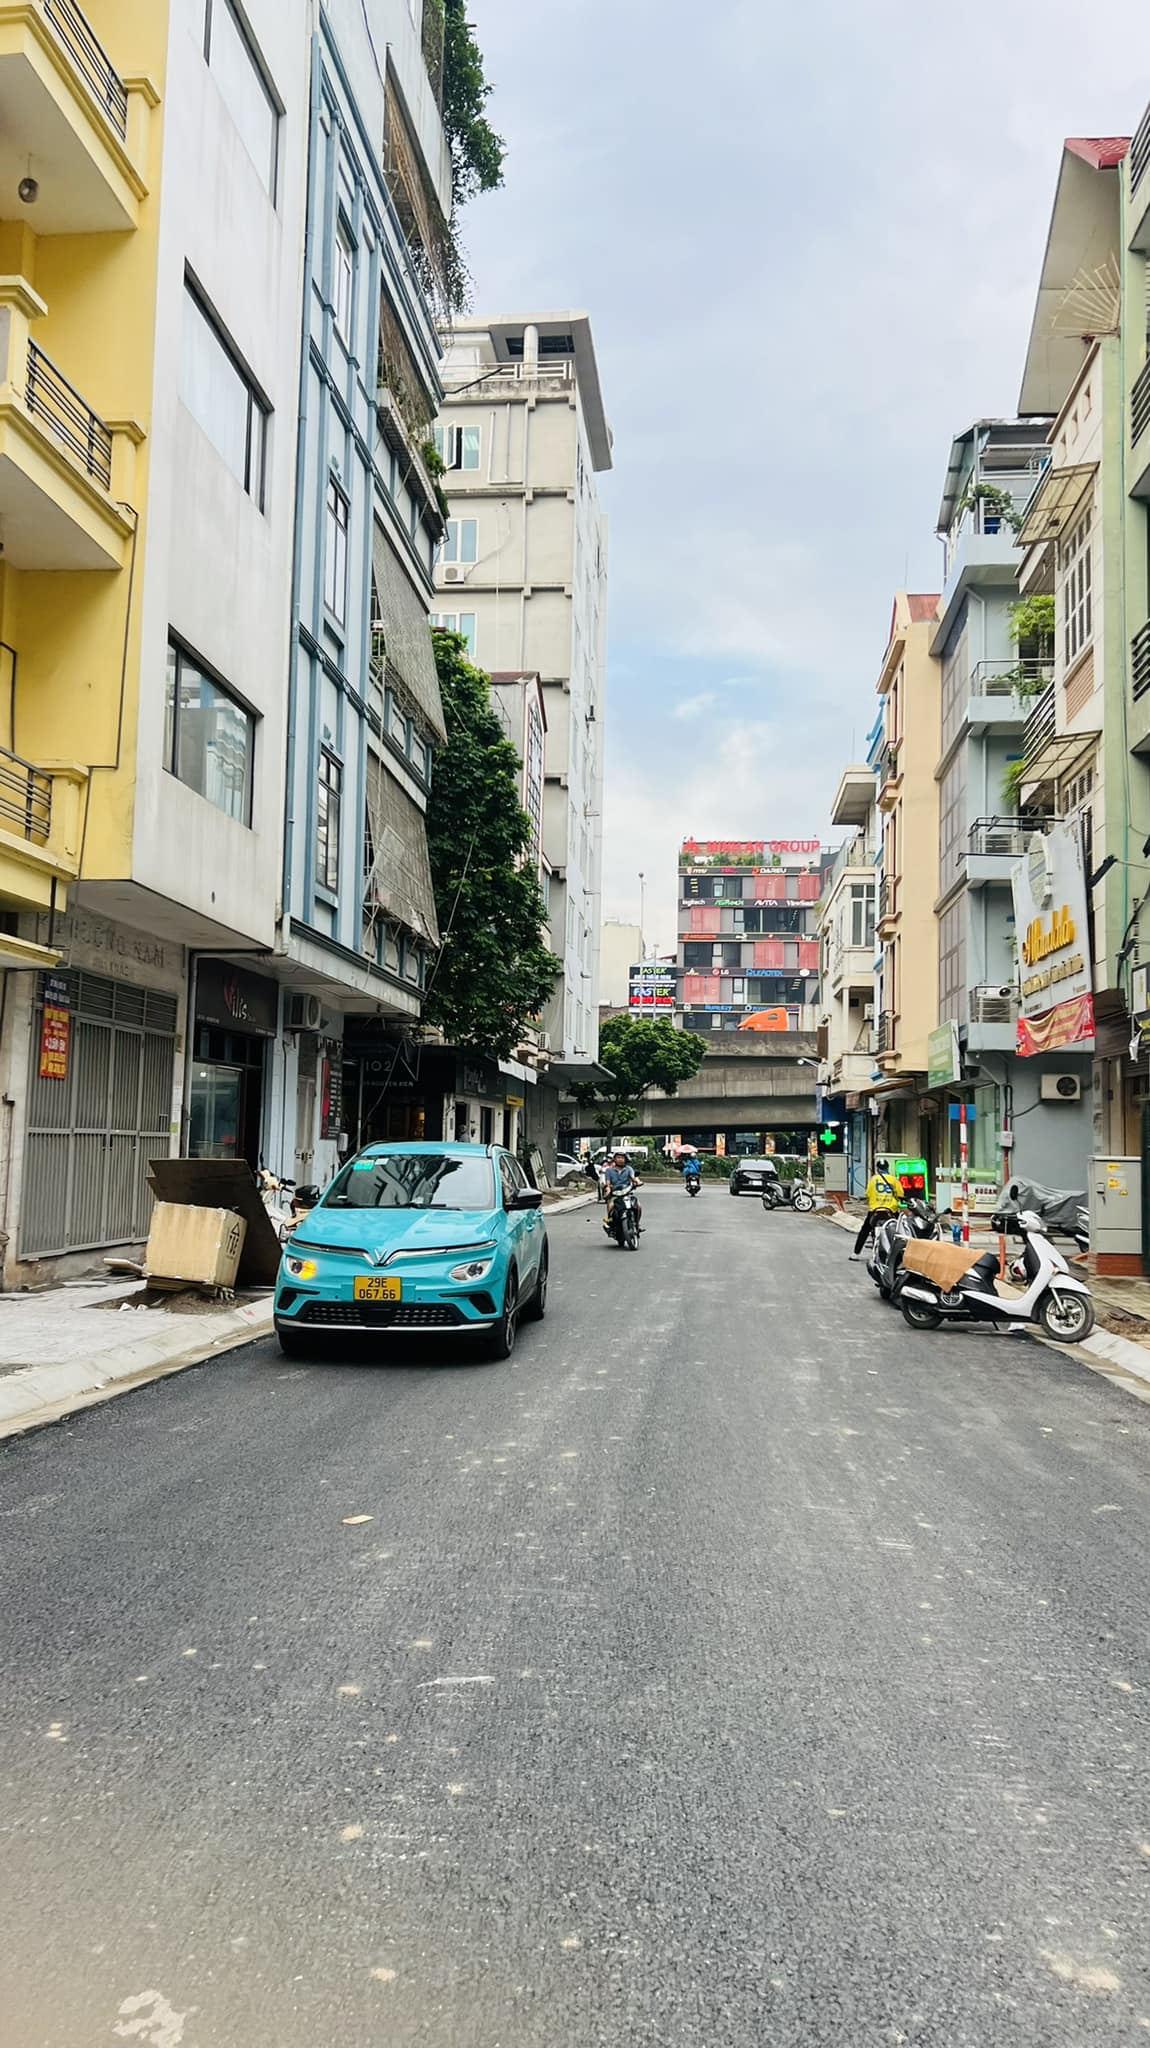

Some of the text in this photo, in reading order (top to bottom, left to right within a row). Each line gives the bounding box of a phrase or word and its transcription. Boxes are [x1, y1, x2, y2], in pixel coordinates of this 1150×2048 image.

[769, 840, 820, 852] GROUP
[367, 1277, 388, 1288] 29E
[359, 1288, 396, 1299] 067.66
